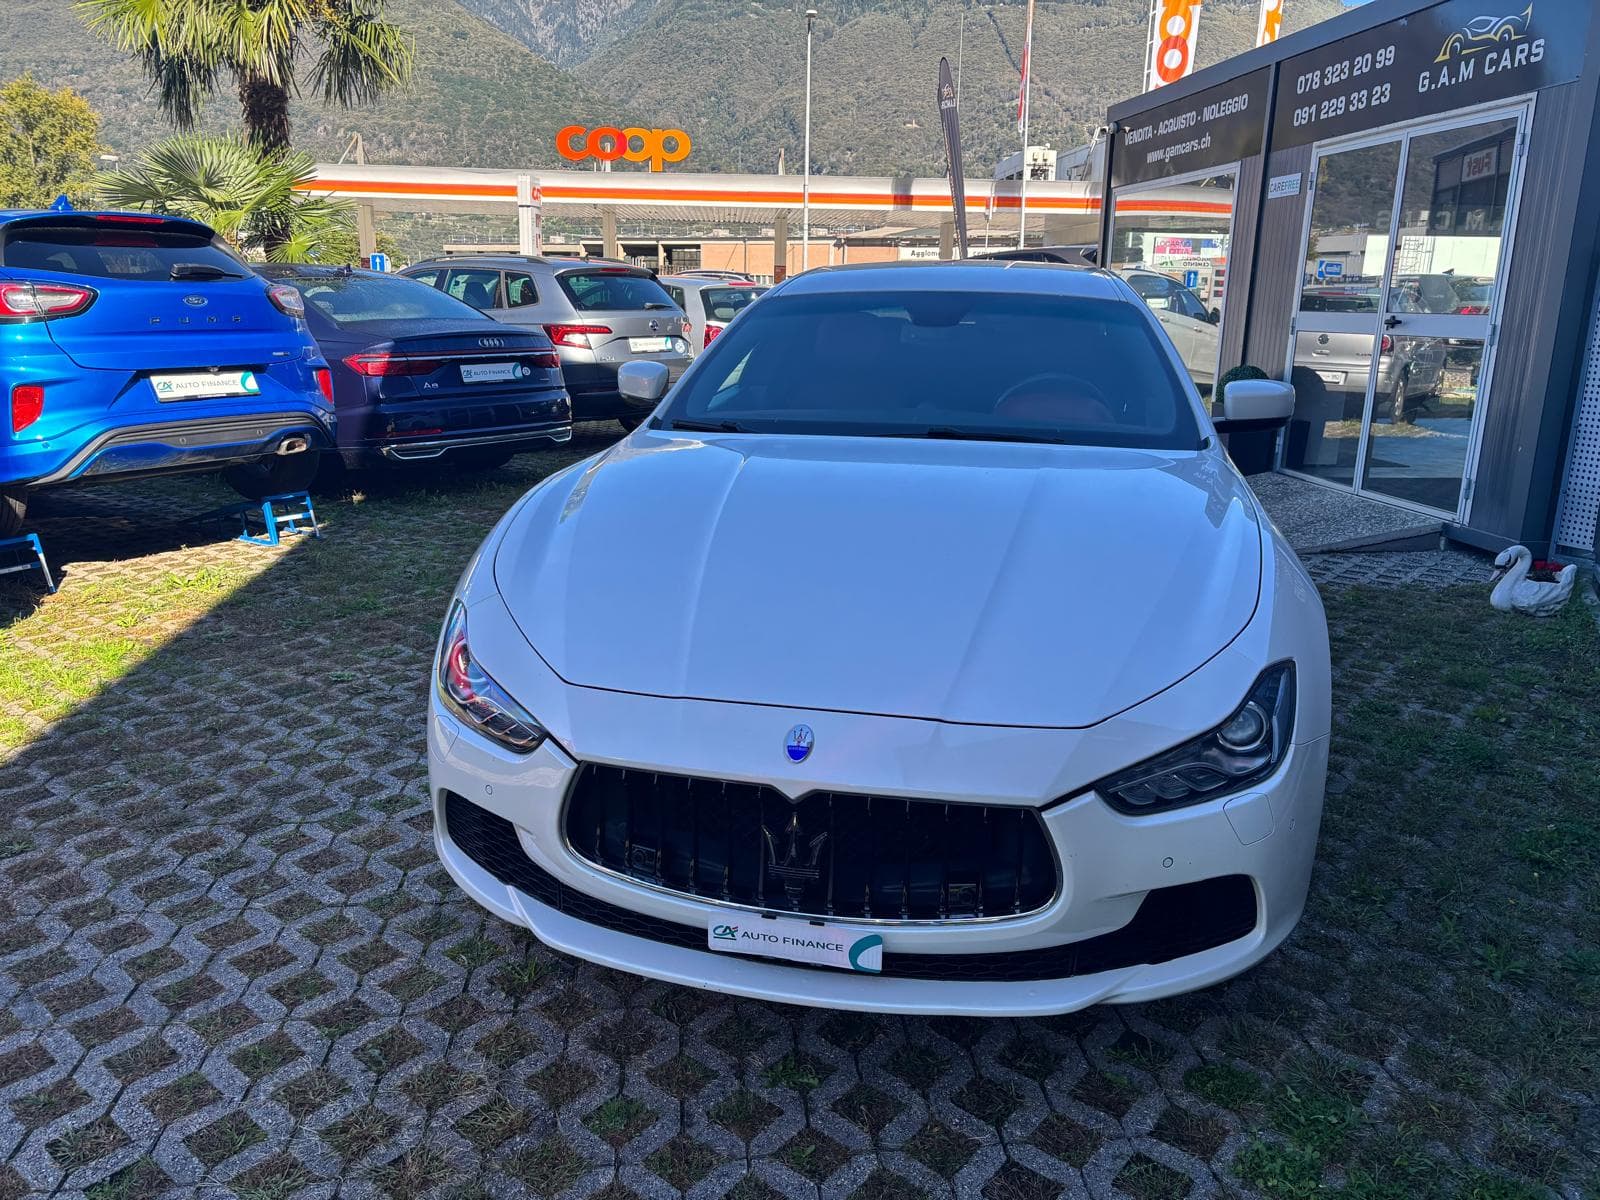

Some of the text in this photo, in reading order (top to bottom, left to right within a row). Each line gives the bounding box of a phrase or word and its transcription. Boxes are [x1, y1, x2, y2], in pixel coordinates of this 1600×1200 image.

[1297, 45, 1395, 94] 078 323 20 99
[1418, 38, 1545, 93] G.A.M CARS
[1124, 125, 1152, 146] VENDITA
[1157, 111, 1197, 136] ACQUISTO
[1202, 93, 1249, 123] NOLEGGIO
[1293, 82, 1391, 127] 091 229 33 23
[555, 125, 692, 172] coop
[1146, 132, 1211, 164] www.gamcars.ch
[1269, 178, 1300, 193] CAREFREE
[176, 382, 200, 390] AUTO
[201, 379, 239, 387] FINANCE
[741, 931, 779, 943] AUTO
[782, 936, 844, 952] FINANCE
